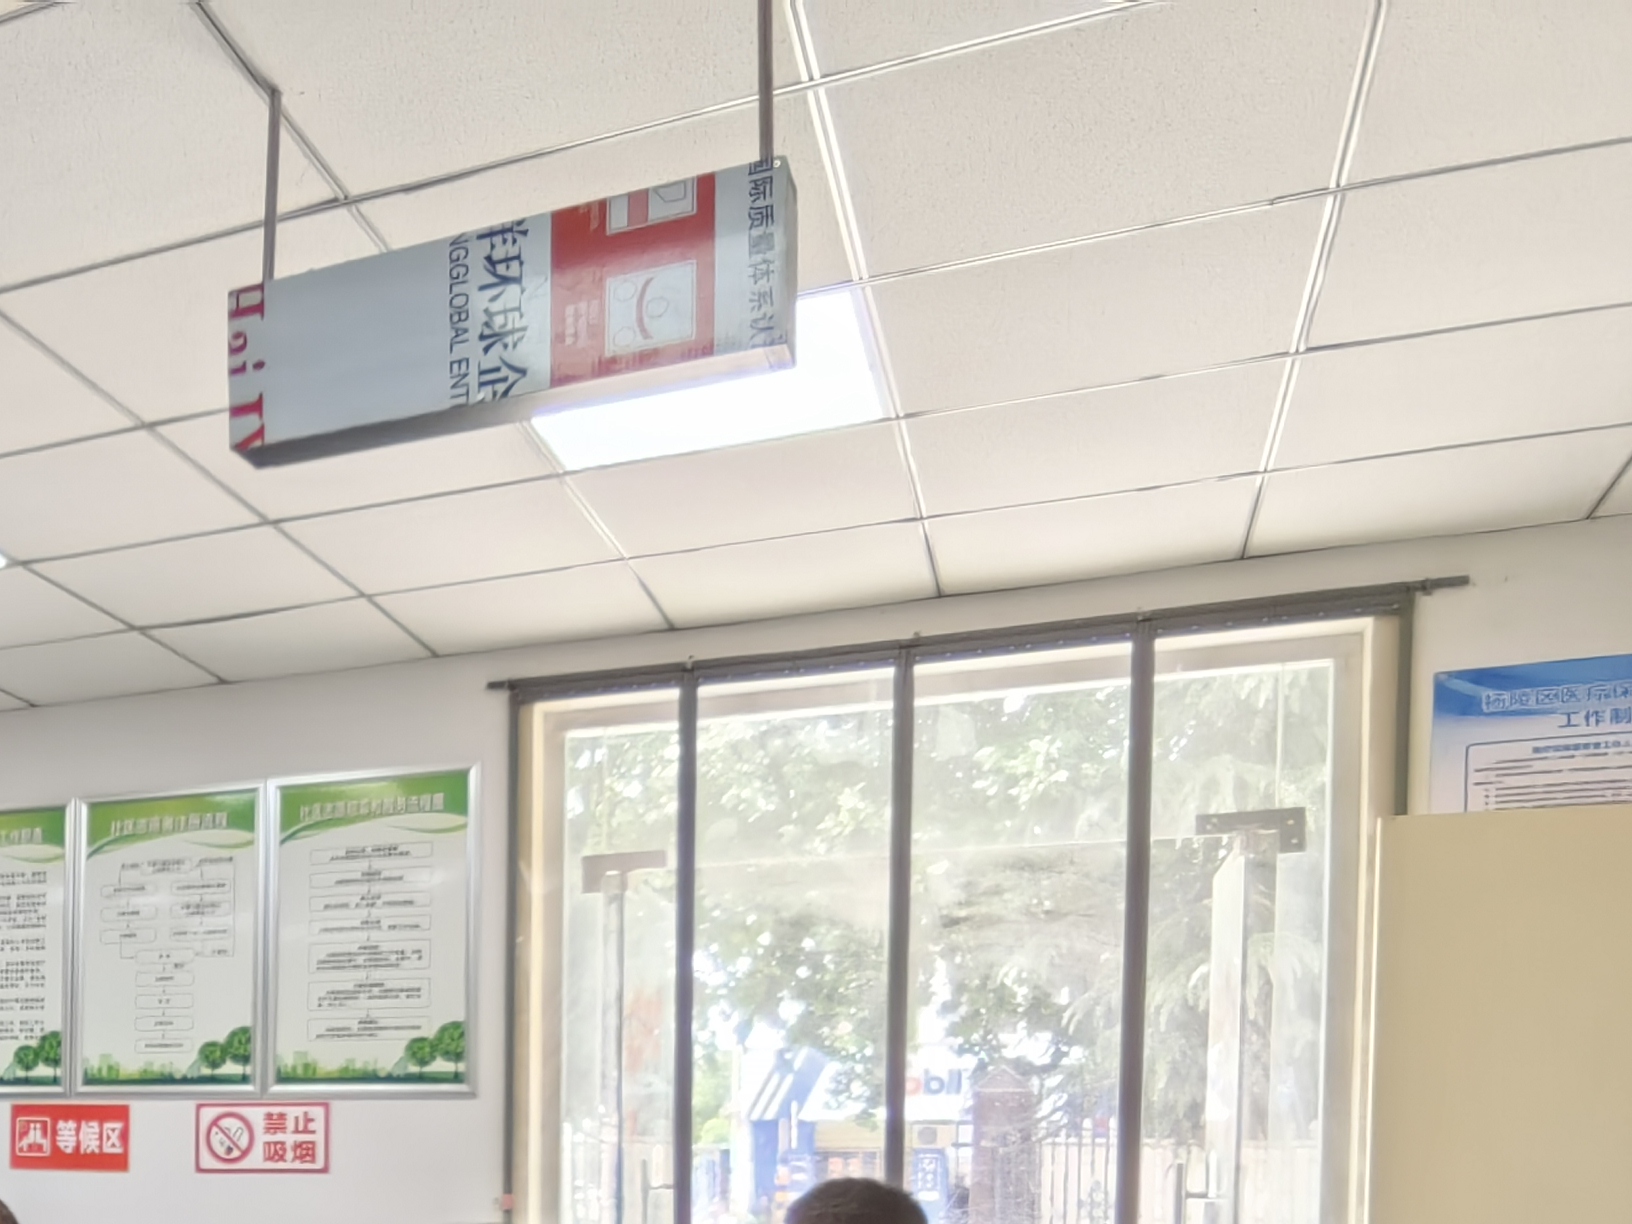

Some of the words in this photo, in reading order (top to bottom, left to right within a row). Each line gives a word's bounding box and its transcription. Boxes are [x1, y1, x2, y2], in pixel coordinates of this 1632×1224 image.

[450, 357, 471, 405] ENT
[56, 1119, 124, 1155] 等候区
[262, 1111, 317, 1136] 禁止
[262, 1140, 317, 1164] 吸烟
